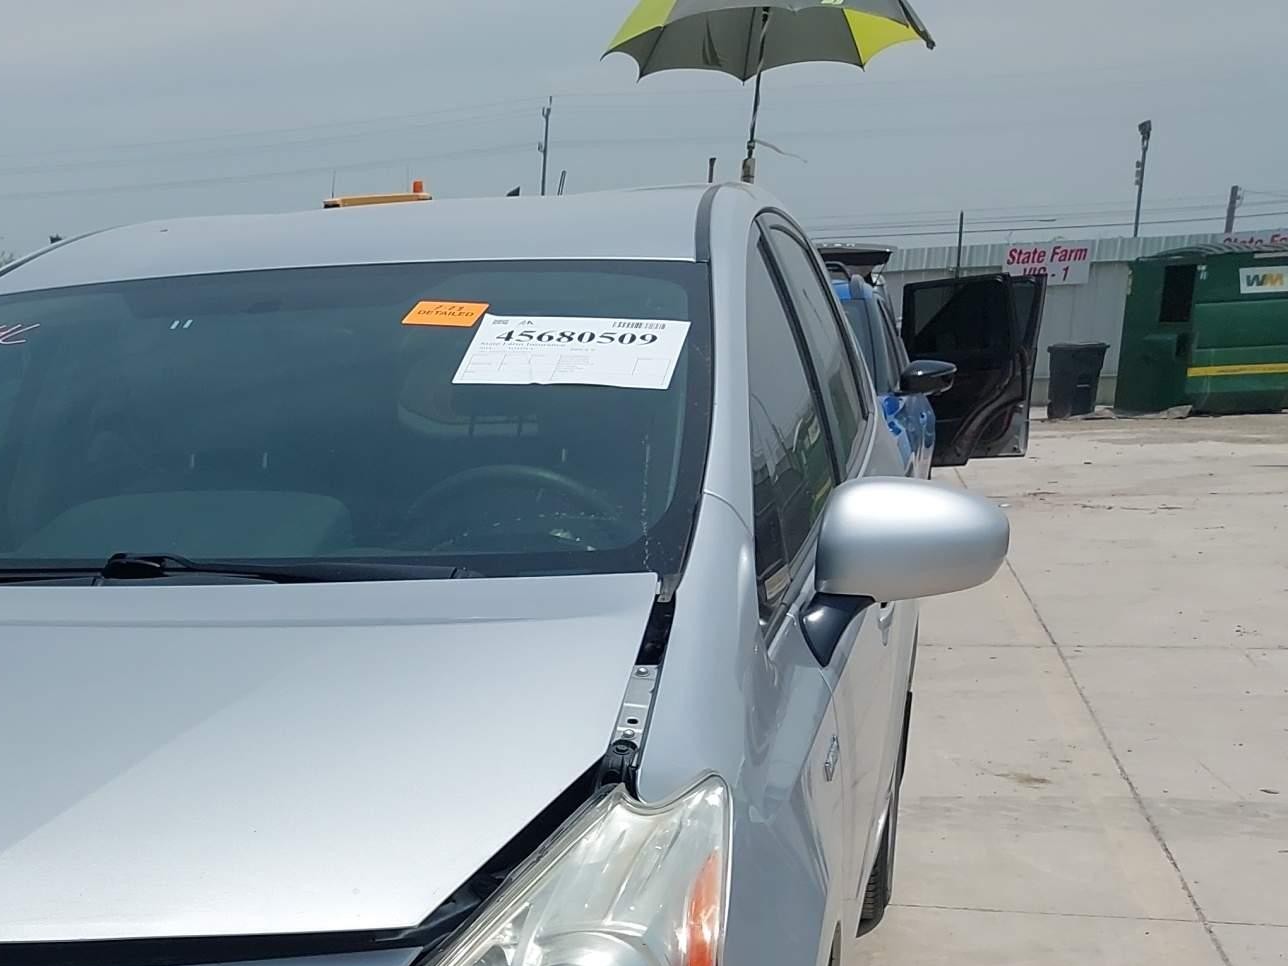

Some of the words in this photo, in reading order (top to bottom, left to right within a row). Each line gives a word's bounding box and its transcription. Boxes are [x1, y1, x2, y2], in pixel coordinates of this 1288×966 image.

[1007, 247, 1046, 265] State
[1050, 245, 1088, 262] Farm
[1062, 266, 1069, 281] 1
[1246, 273, 1284, 287] WM
[417, 309, 475, 317] DETAILED
[495, 329, 659, 346] 45680509
